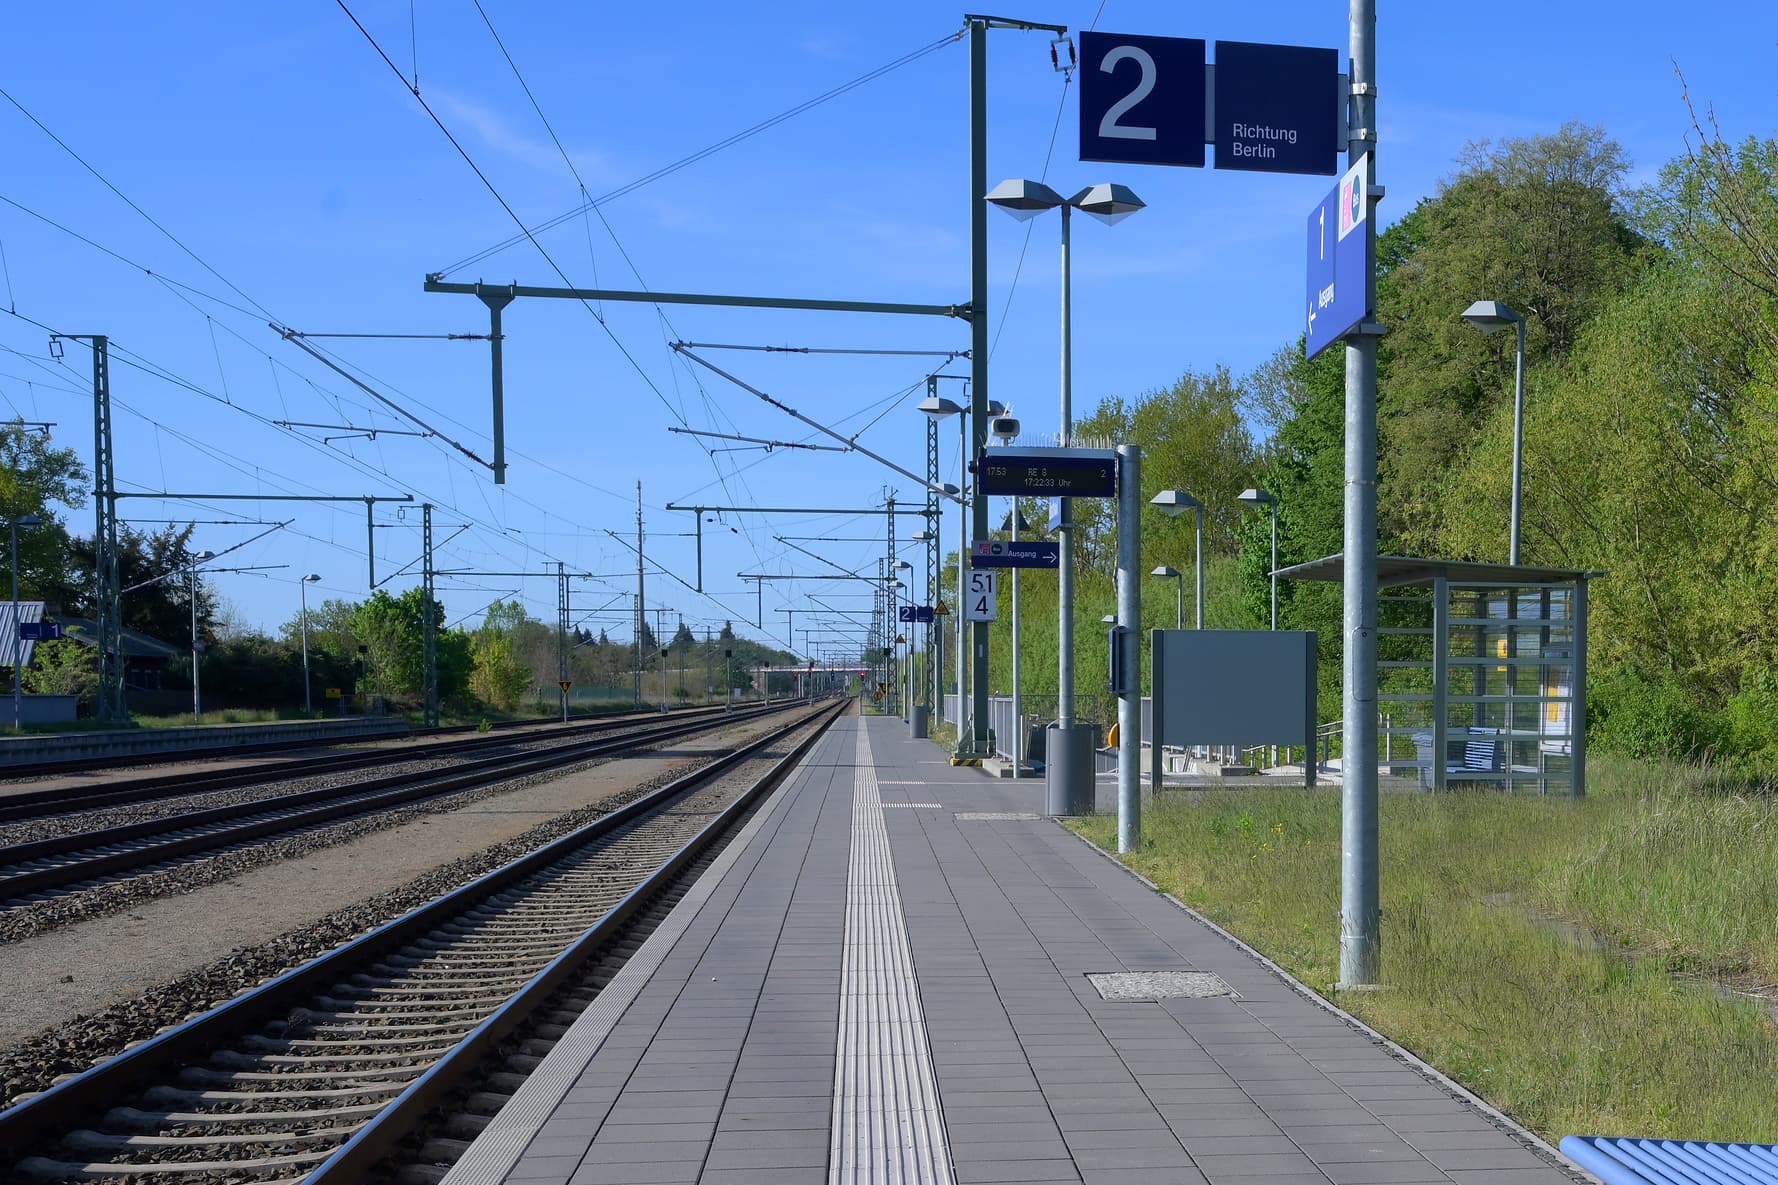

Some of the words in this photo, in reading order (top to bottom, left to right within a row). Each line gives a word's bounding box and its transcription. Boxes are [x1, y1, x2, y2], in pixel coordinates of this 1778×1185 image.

[1098, 45, 1157, 141] 2
[1233, 123, 1297, 144] Richtung
[1233, 142, 1275, 159] Berlin
[1319, 206, 1325, 260] 1
[1028, 467, 1038, 477] RE
[1100, 469, 1107, 478] 2
[1058, 479, 1071, 487] Uhr
[1008, 550, 1037, 559] Ausgang
[971, 573, 992, 593] 51
[901, 607, 911, 620] 2
[974, 595, 989, 615] 4
[51, 623, 59, 638] 1
